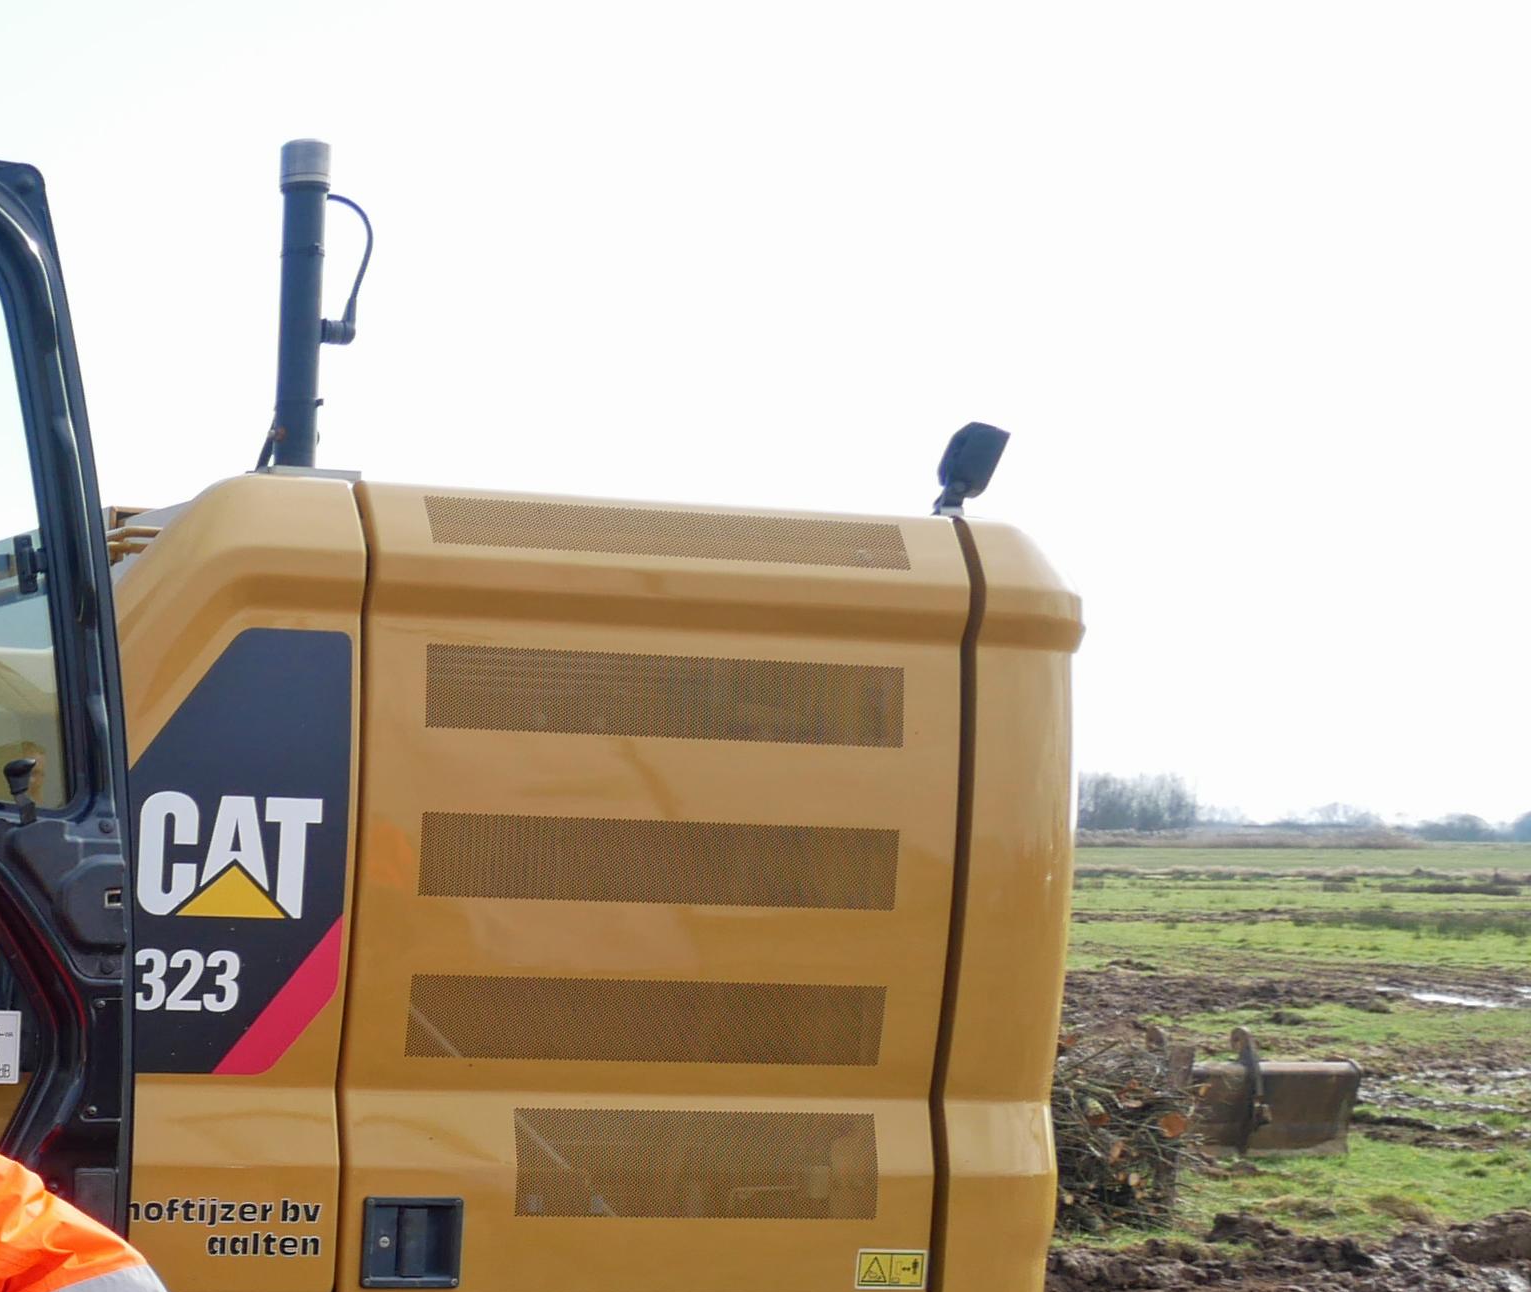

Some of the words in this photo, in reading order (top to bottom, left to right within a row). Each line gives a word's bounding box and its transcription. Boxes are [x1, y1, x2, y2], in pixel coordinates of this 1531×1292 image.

[137, 791, 323, 919] CAT
[135, 949, 241, 1012] 323
[281, 1199, 322, 1223] bv
[207, 1232, 321, 1256] aalten
